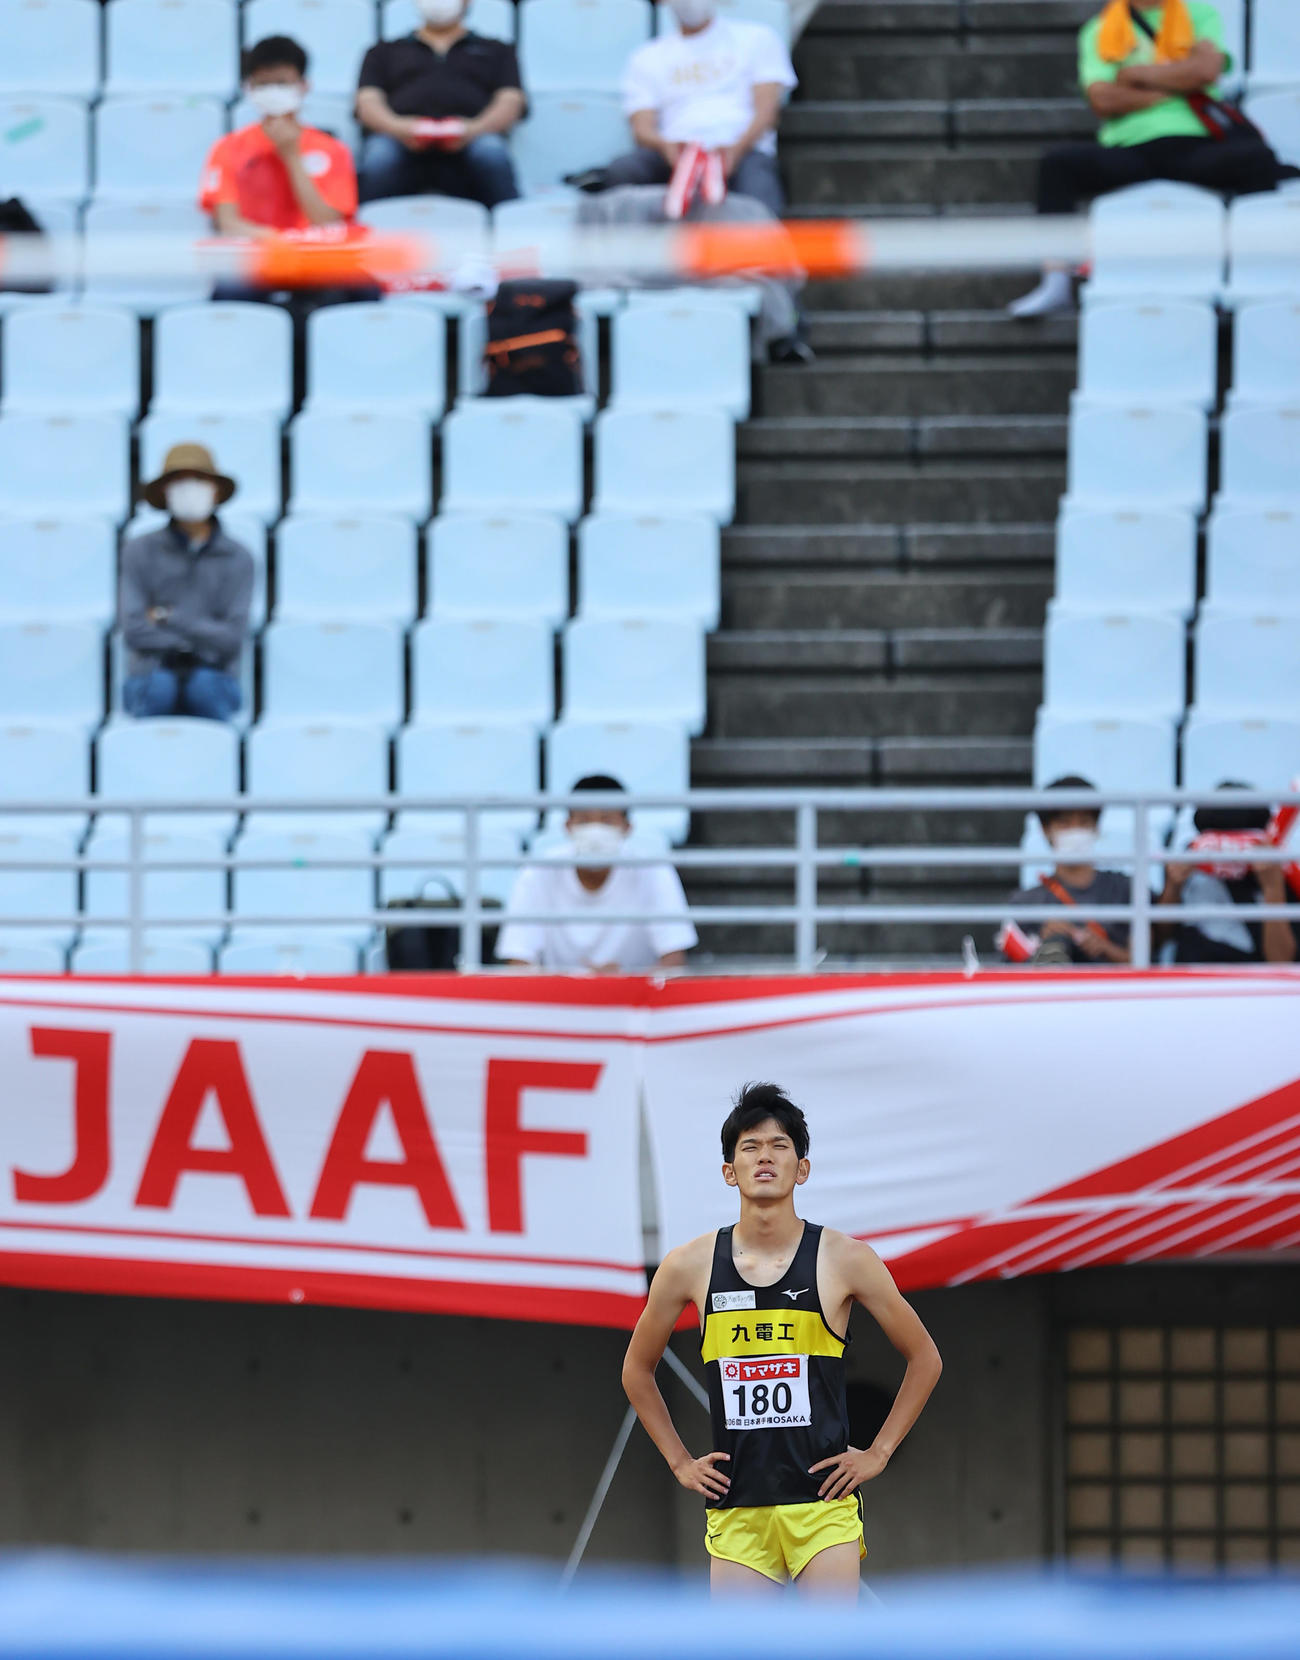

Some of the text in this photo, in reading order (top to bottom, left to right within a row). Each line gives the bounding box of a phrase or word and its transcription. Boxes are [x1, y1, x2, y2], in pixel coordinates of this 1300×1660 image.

[12, 1026, 606, 1235] JAAF
[732, 1323, 794, 1343] 九電工
[743, 1362, 797, 1377] ヤマザキ
[733, 1382, 792, 1417] 180
